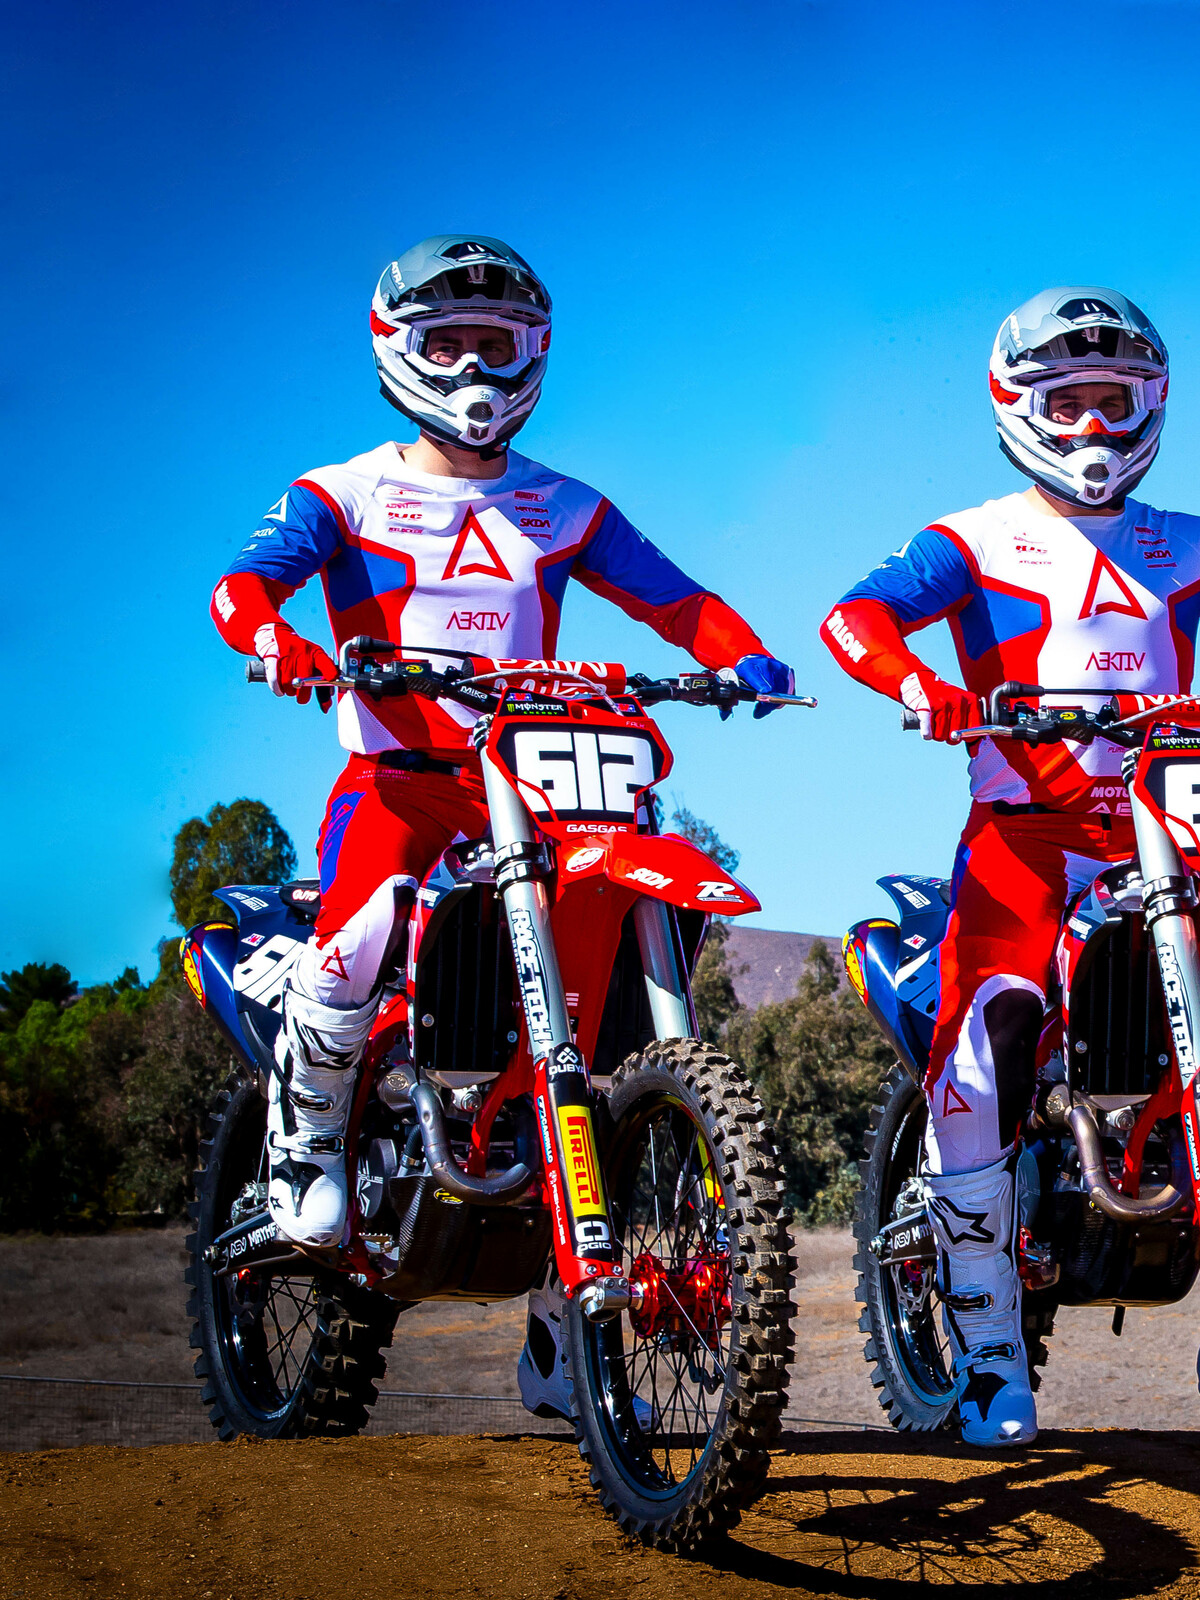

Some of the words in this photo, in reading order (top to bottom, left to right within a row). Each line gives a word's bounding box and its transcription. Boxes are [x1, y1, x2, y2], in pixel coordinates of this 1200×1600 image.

[515, 702, 565, 711] MONSTER
[513, 731, 655, 813] 612
[566, 824, 627, 834] GASGAS
[292, 889, 320, 901] GUTS
[510, 910, 541, 974] RACE
[524, 975, 553, 1041] TECH
[1158, 945, 1185, 1010] RACE
[1171, 1010, 1197, 1074] TECH
[567, 1116, 600, 1205] PIRELLI
[577, 1242, 612, 1250] OGIO
